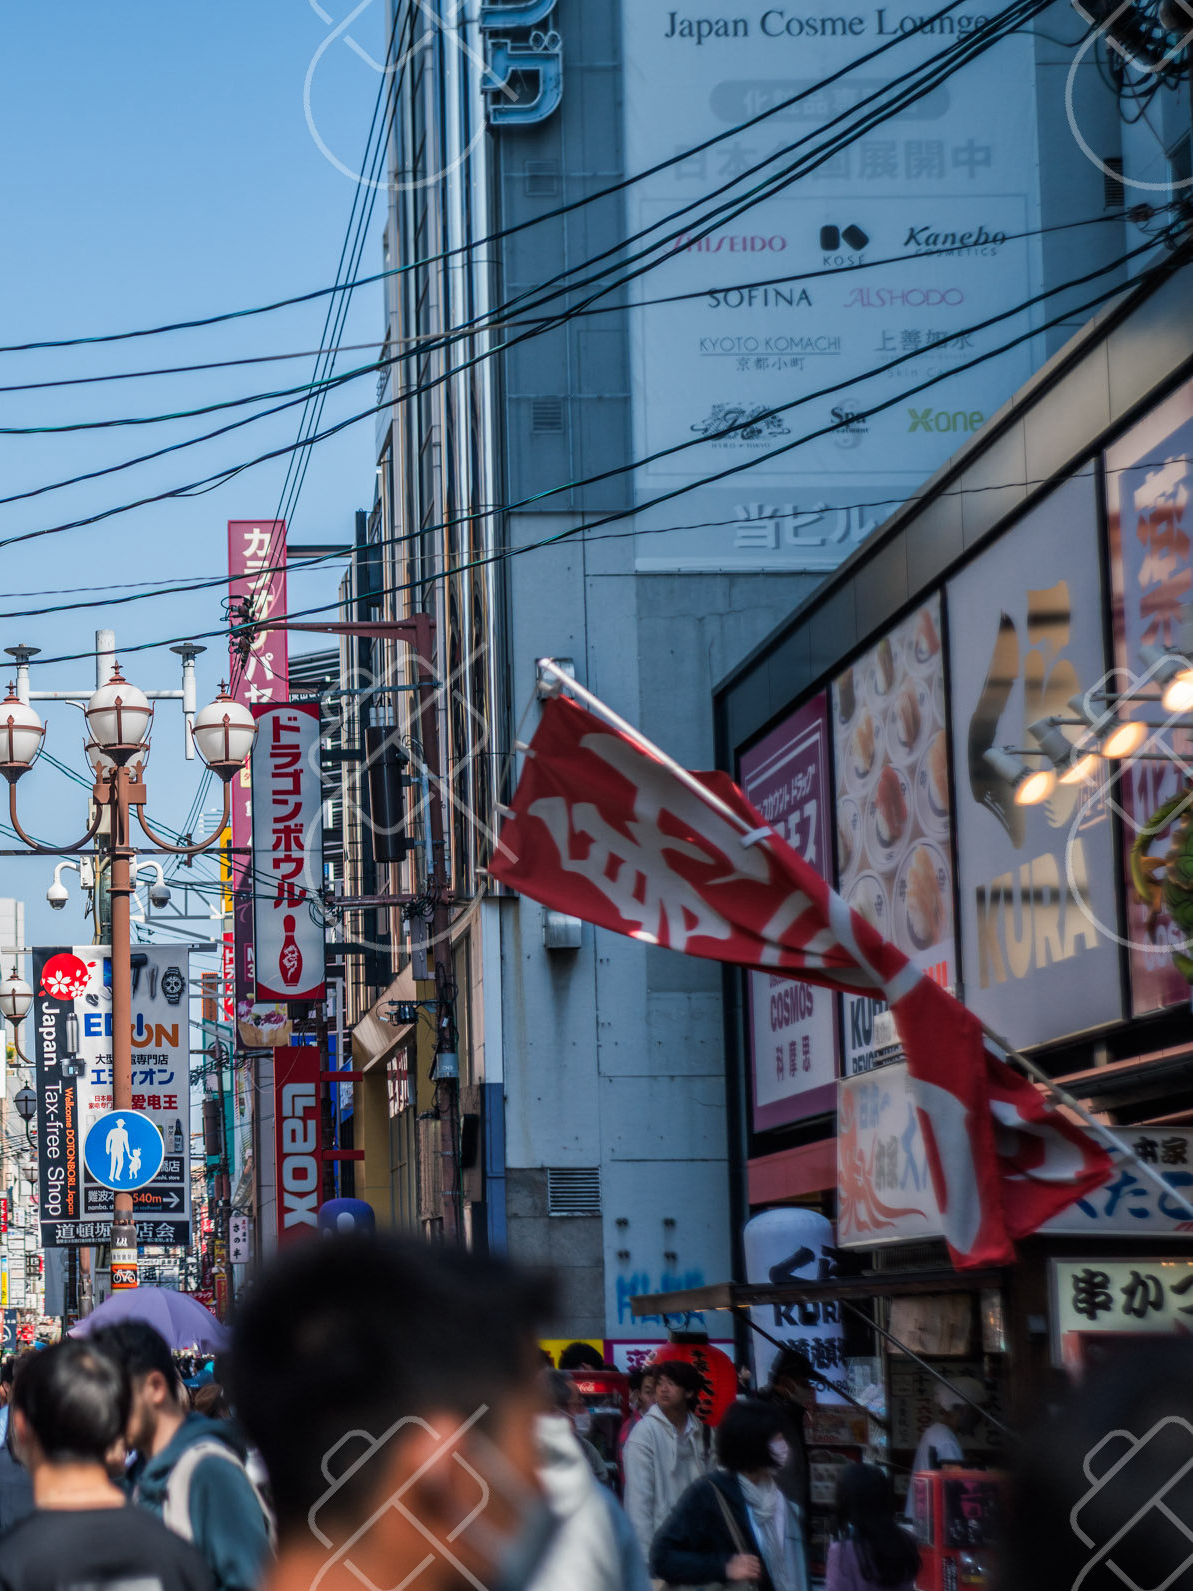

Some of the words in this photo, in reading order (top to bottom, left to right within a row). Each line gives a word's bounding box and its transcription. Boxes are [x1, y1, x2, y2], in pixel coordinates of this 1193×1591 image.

[665, 12, 749, 46] Japan
[760, 7, 864, 38] Cosme
[876, 5, 990, 41] Lounge
[664, 232, 787, 254] SHISEIDO
[904, 225, 1007, 247] Kanebo
[708, 288, 812, 308] SOFINA
[700, 336, 761, 351] KYOTO
[765, 336, 841, 351] KOMACHI
[736, 357, 806, 372] 京都小町
[830, 407, 868, 426] Spa
[269, 716, 306, 908] ドラゴンボウル
[976, 837, 1099, 989] KURA
[770, 980, 814, 1031] COSMOS
[43, 1001, 60, 1071] Japan.
[96, 1054, 168, 1065] 大型専門店
[45, 1080, 64, 1159] Tax-free
[45, 1166, 65, 1216] Shop
[65, 1190, 76, 1215] Japan
[56, 1223, 175, 1239] 道頓堀店会
